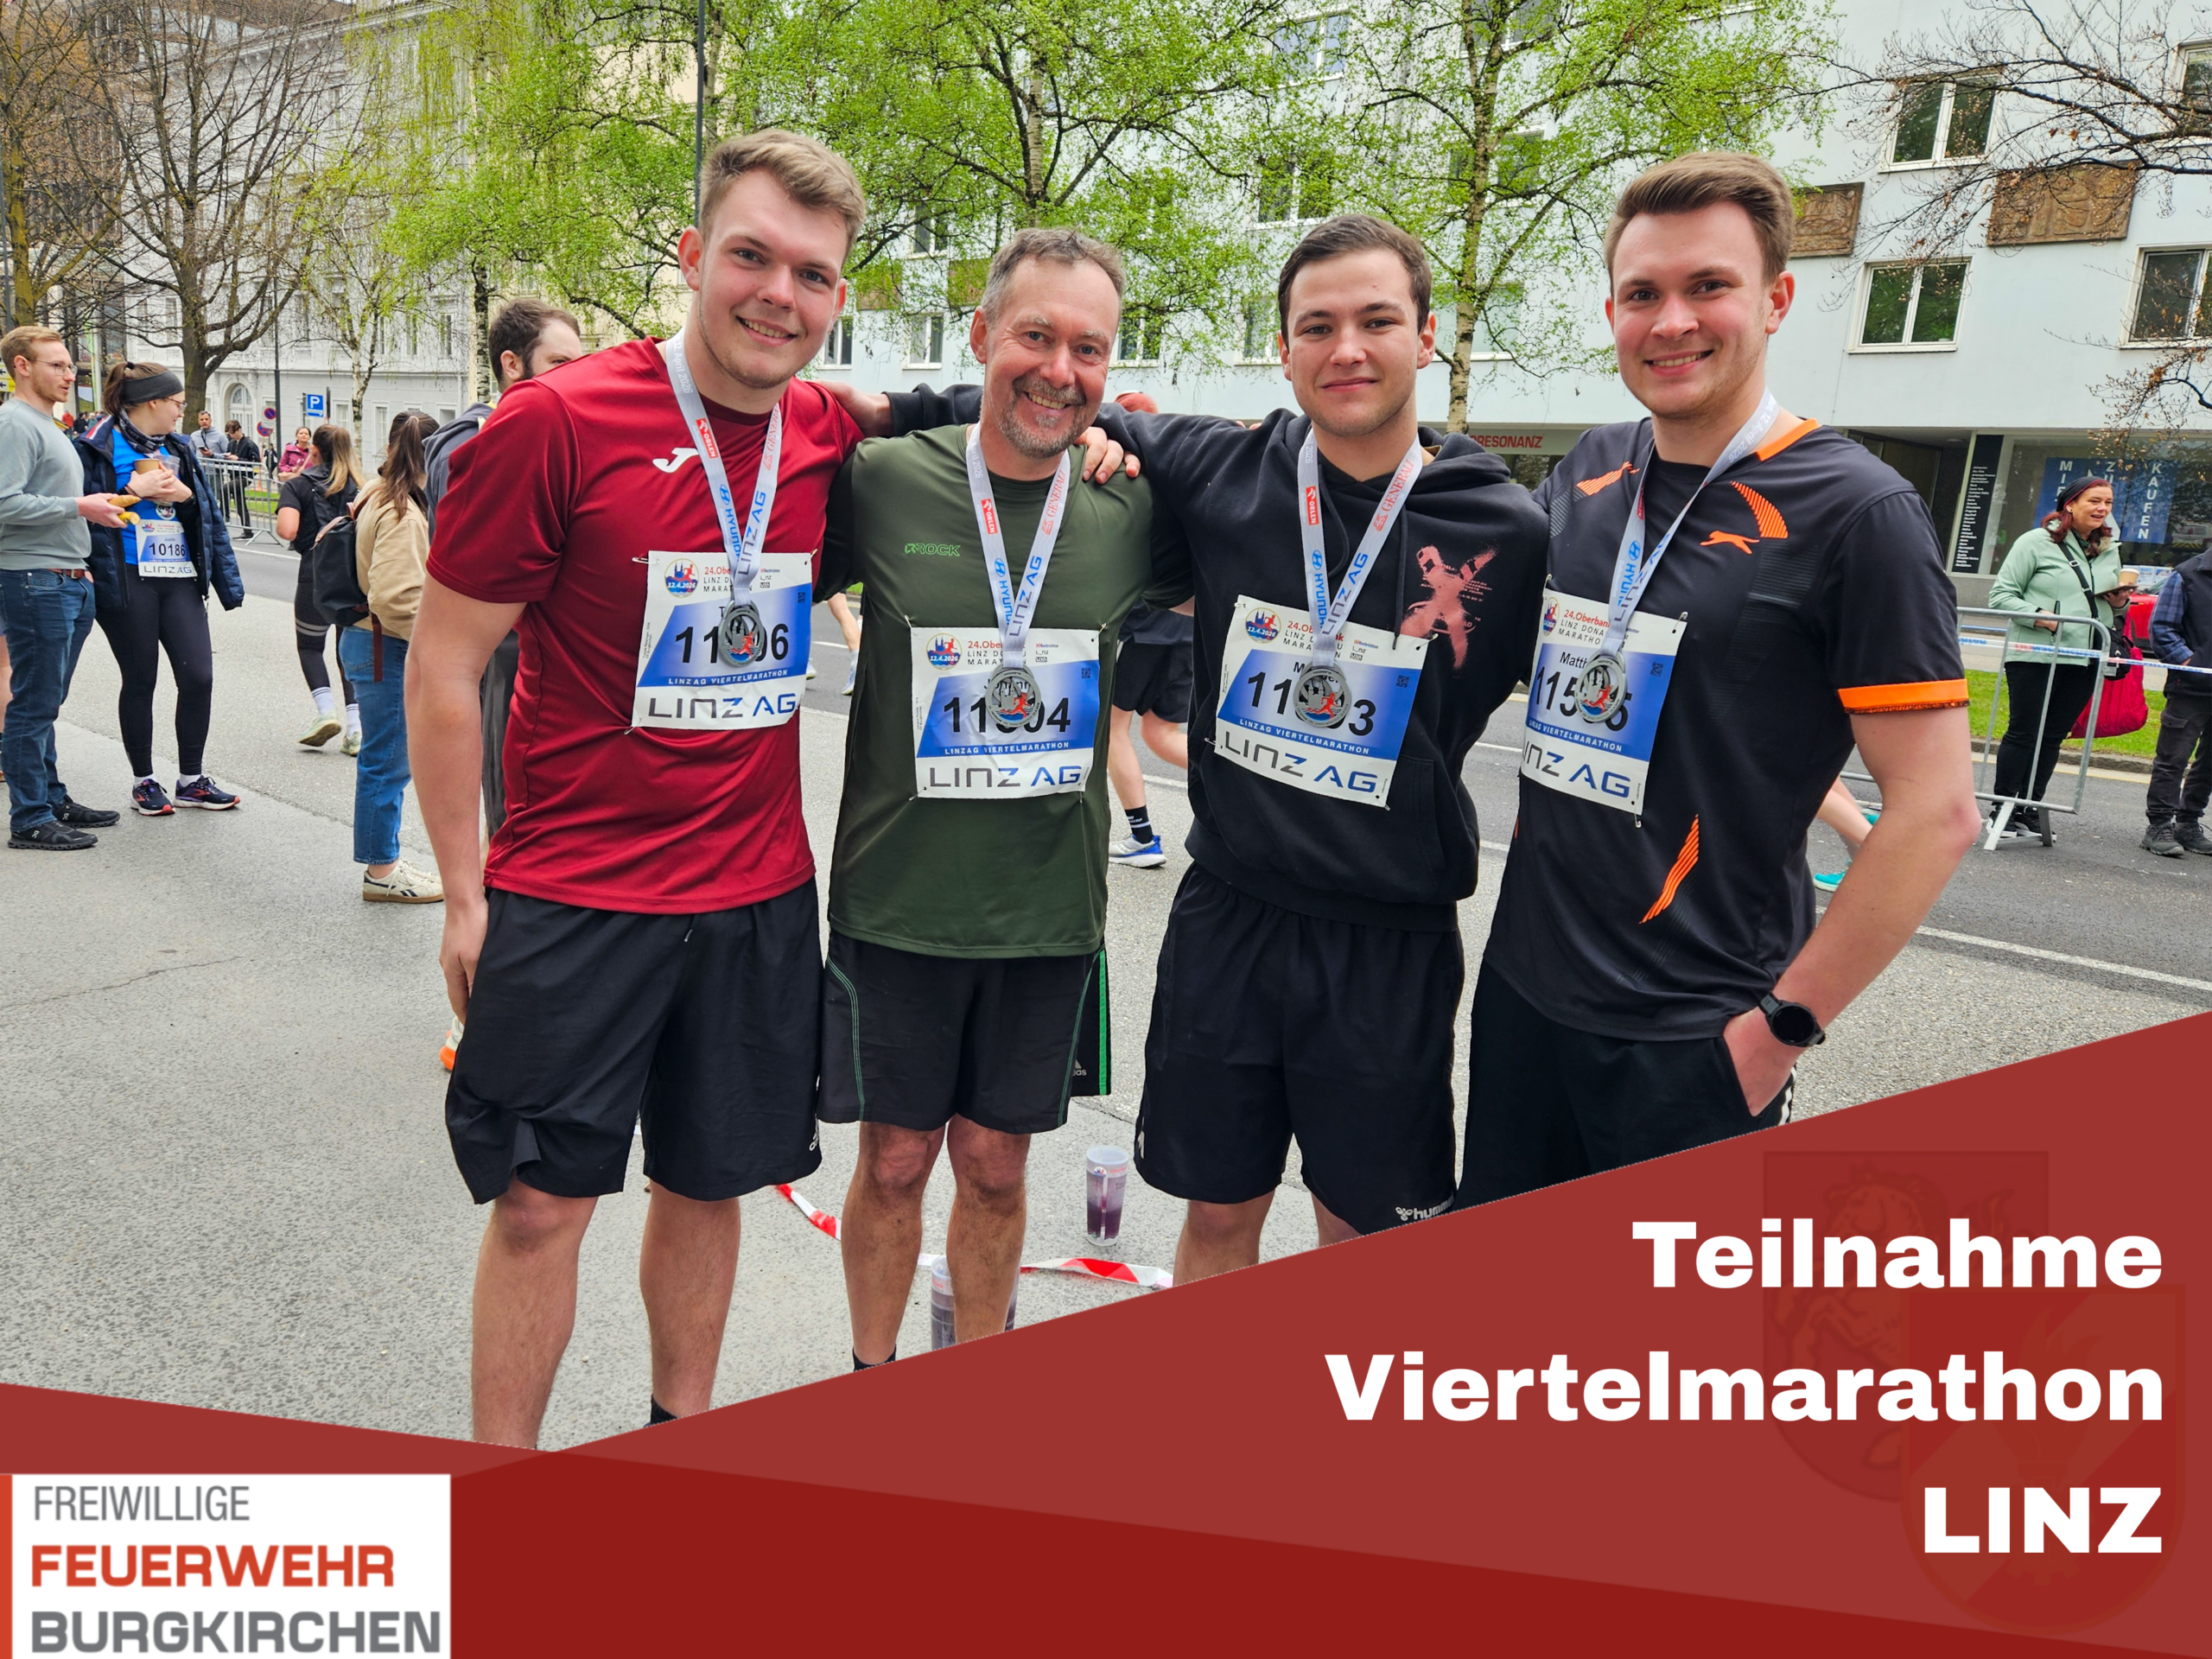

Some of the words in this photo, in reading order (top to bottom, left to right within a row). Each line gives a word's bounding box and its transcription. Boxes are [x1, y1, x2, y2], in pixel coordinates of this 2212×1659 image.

[677, 373, 693, 394] 2026
[310, 396, 321, 409] P
[703, 434, 716, 458] ORLEN
[1305, 446, 1313, 464] 2026
[973, 461, 984, 479] 2026
[1046, 470, 1066, 518] GENERALI
[1381, 459, 1415, 512] GENERALI
[1309, 500, 1319, 524] ORLEN
[2138, 463, 2162, 539] KAUFEN
[738, 525, 758, 575] LINZ
[752, 490, 766, 524] AG
[986, 511, 996, 533] ORLEN
[149, 543, 186, 556] 10186
[144, 565, 175, 574] LINZ
[1009, 589, 1033, 636] LINZ
[1026, 556, 1042, 586] AG
[1322, 588, 1351, 635] LINZ
[1348, 552, 1369, 584] AG
[1560, 620, 1578, 629] LINZ
[1581, 625, 1605, 637] DONA
[1564, 609, 1611, 628] 24.Oberban
[1247, 626, 1277, 638] 12.4.2026
[1285, 630, 1306, 641] LINZ
[1558, 628, 1601, 645] MARATHO
[711, 669, 787, 684] VIERTELMARATHON
[648, 697, 743, 719] LINZ
[753, 693, 797, 716] AG
[984, 741, 1069, 753] VIERTELMARATHON
[1275, 728, 1370, 754] VIERTELMARATHON
[1542, 725, 1623, 752] VIERTELMARATHON
[1225, 731, 1307, 778] LINZ
[1313, 765, 1378, 793] AG
[930, 767, 1020, 787] LINZ
[1030, 766, 1082, 786] AG
[1568, 763, 1631, 798] AG
[1414, 1196, 1454, 1220] humme
